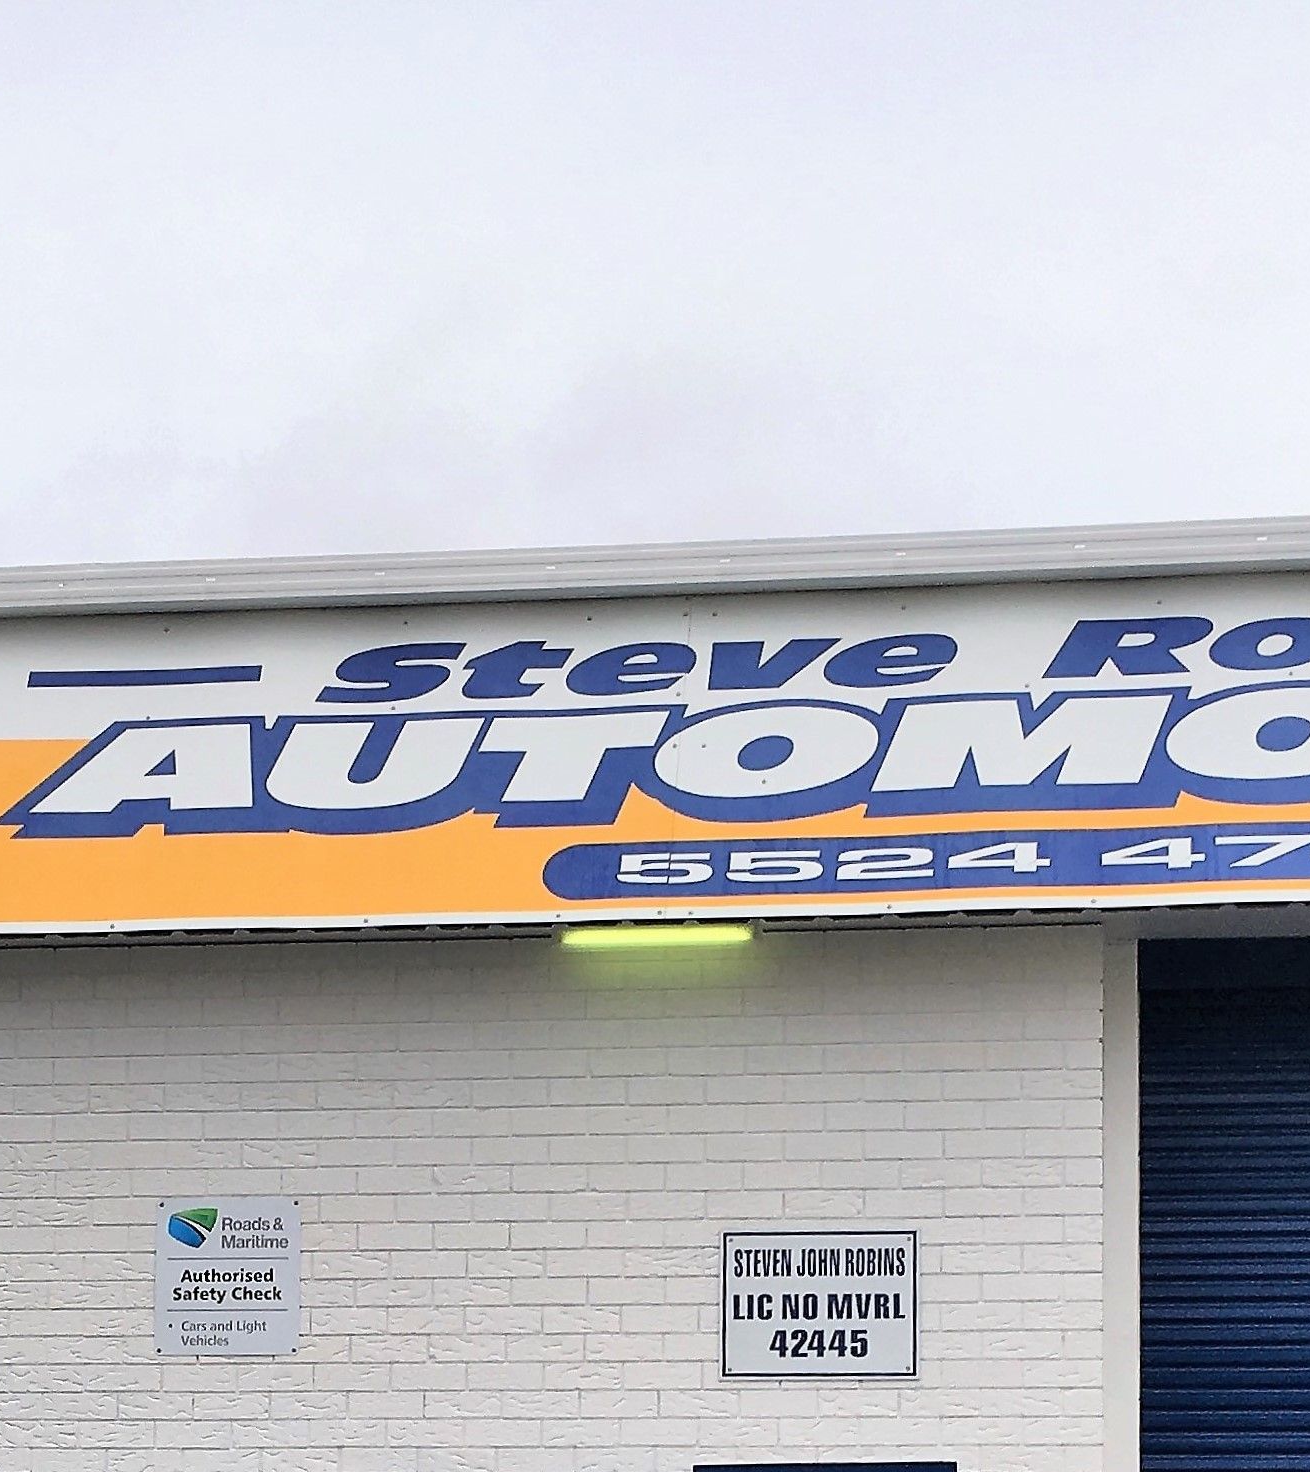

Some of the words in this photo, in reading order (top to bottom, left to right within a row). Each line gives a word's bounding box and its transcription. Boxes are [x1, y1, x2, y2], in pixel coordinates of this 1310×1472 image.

[315, 632, 957, 704] Steve
[616, 841, 1051, 886] 5524
[221, 1216, 270, 1231] Roads
[272, 1217, 284, 1231] &
[221, 1234, 289, 1249] Maritime
[733, 1248, 792, 1278] STEVEN
[796, 1248, 841, 1277] JOHN
[844, 1247, 906, 1277] ROBINS
[180, 1268, 274, 1283] Authorised
[172, 1287, 227, 1304] Safety
[231, 1286, 282, 1301] Check
[732, 1293, 773, 1321] LIC
[781, 1293, 819, 1320] NO
[827, 1293, 906, 1319] MVRL
[181, 1320, 207, 1332] Cars
[210, 1320, 233, 1332] and
[236, 1320, 267, 1334] Light
[181, 1335, 229, 1347] Vehicles
[769, 1329, 869, 1358] 42445
